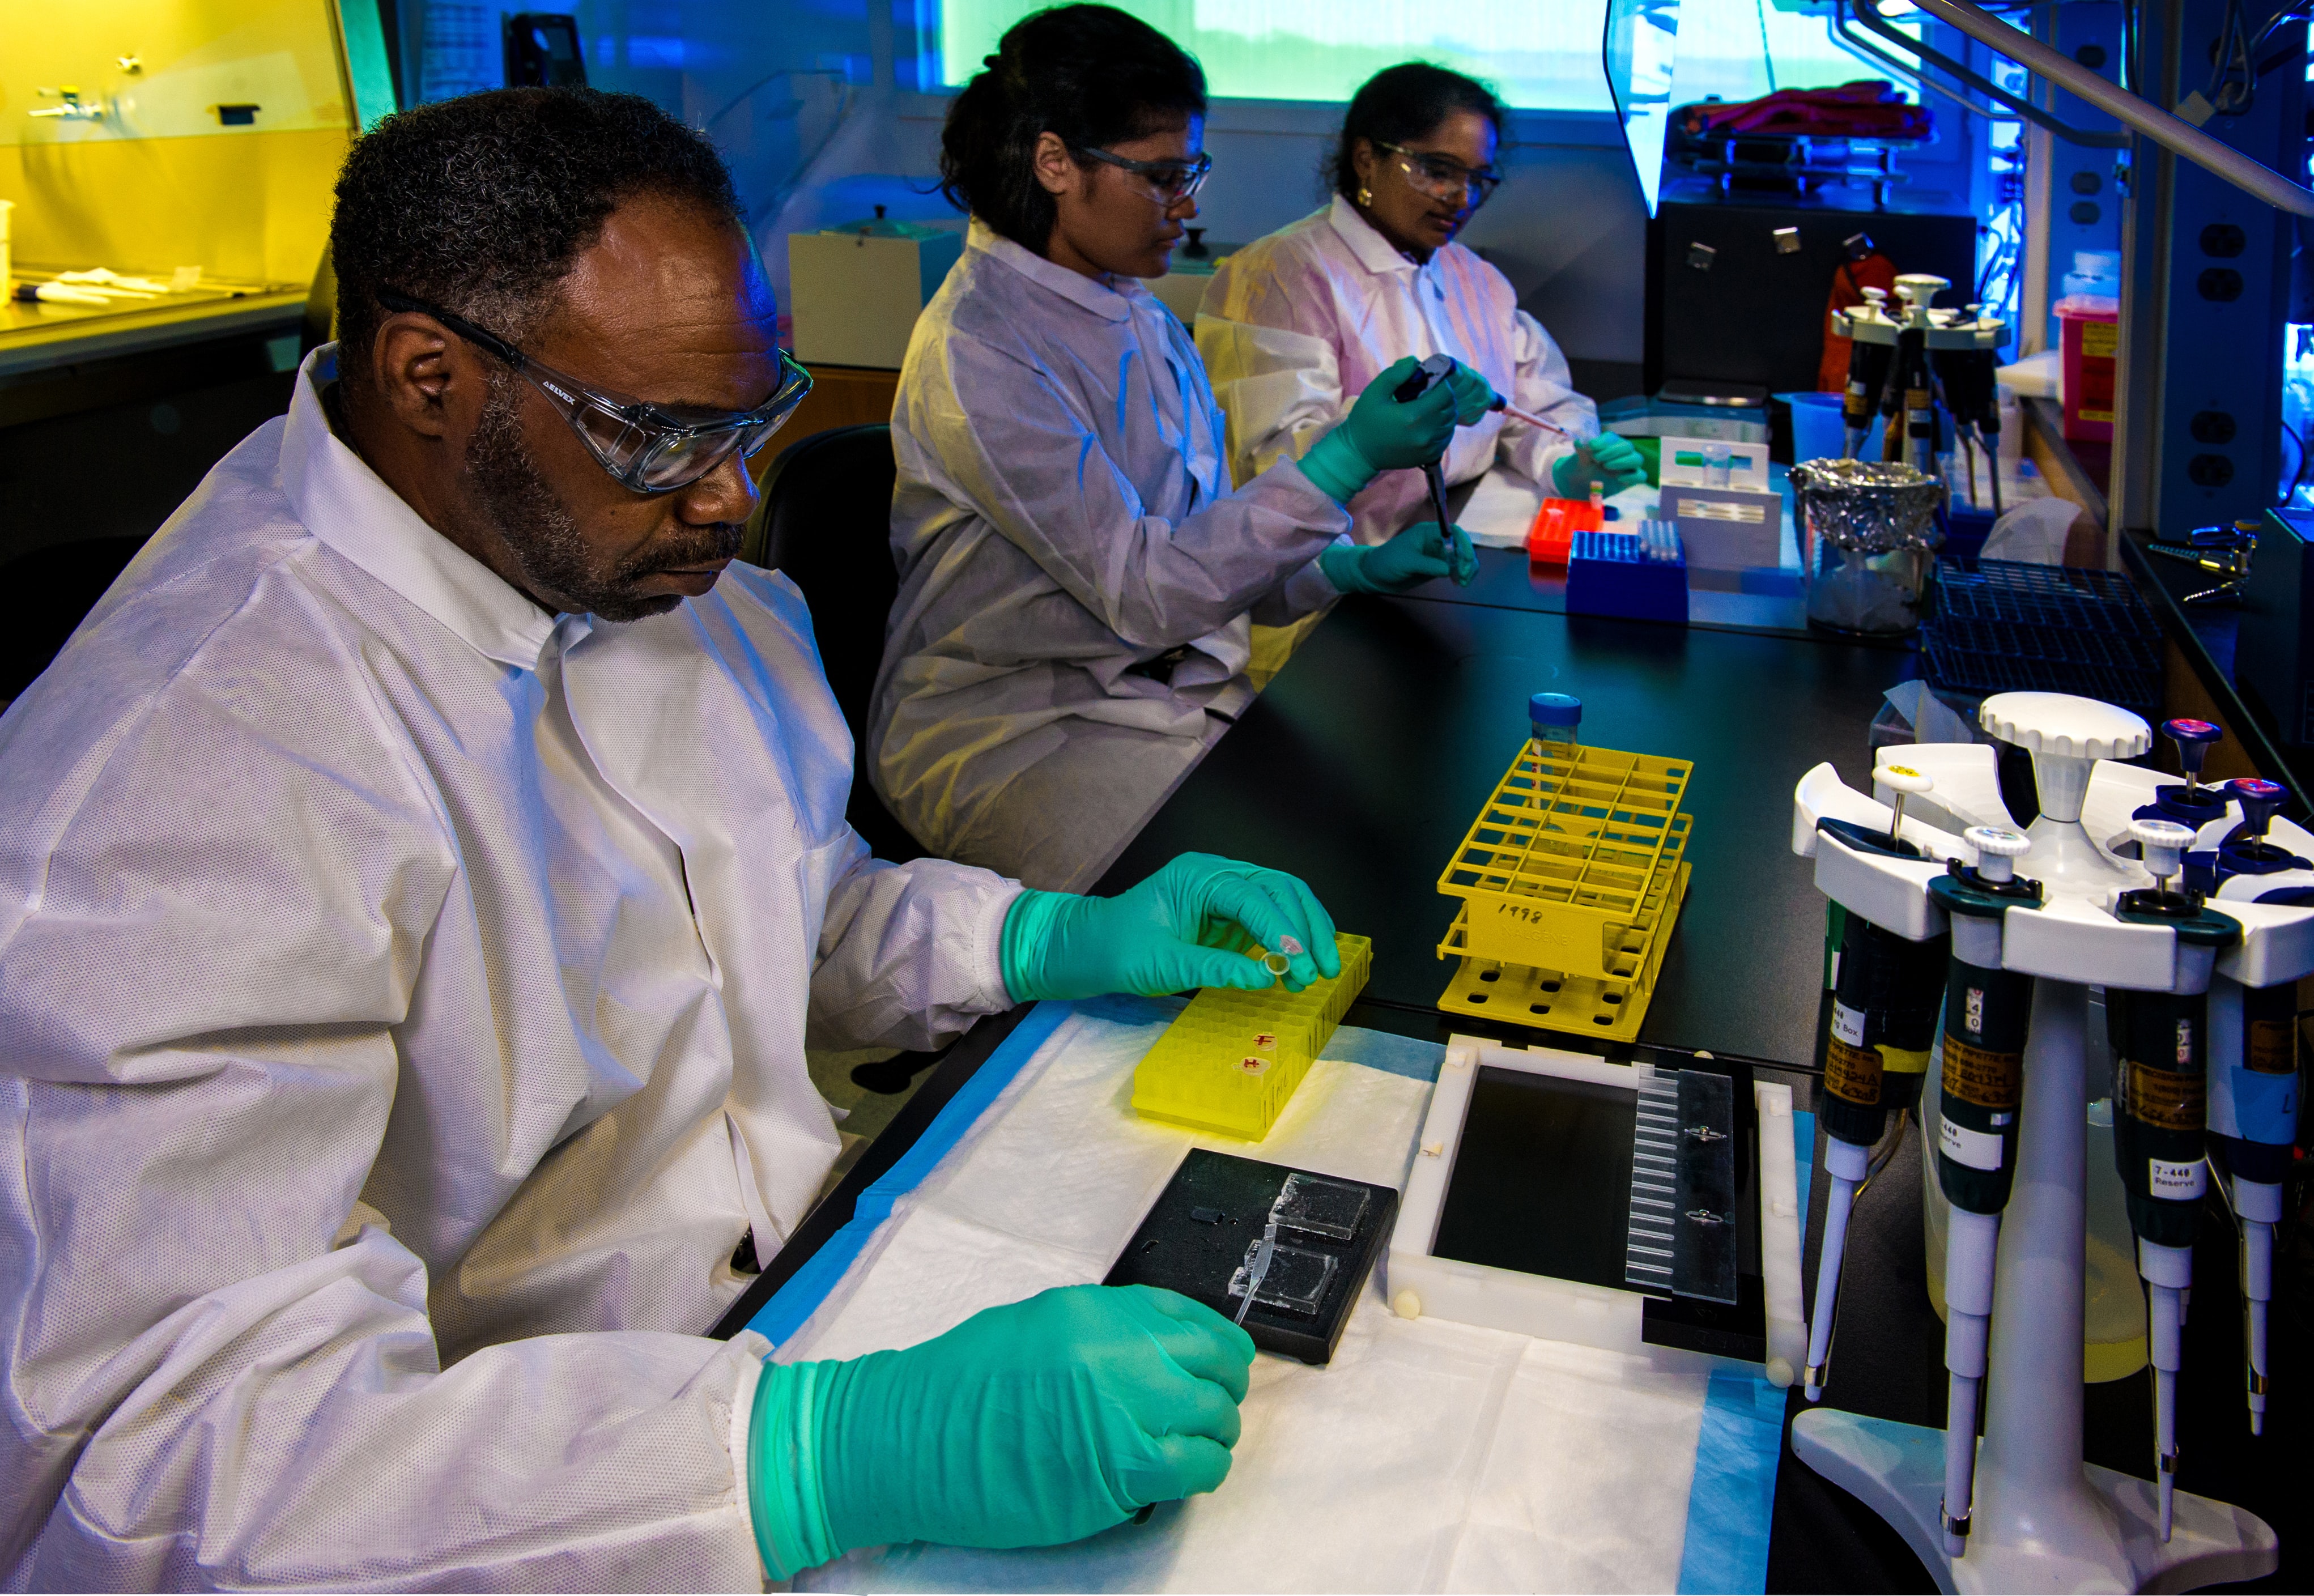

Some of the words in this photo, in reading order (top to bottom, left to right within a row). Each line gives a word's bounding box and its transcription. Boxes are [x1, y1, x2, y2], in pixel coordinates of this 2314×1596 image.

[548, 384, 576, 405] ELVEX
[1498, 903, 1543, 924] 1998
[1501, 925, 1568, 947] NALGENE
[1843, 1024, 1858, 1037] Box
[2154, 1176, 2195, 1187] Reserve
